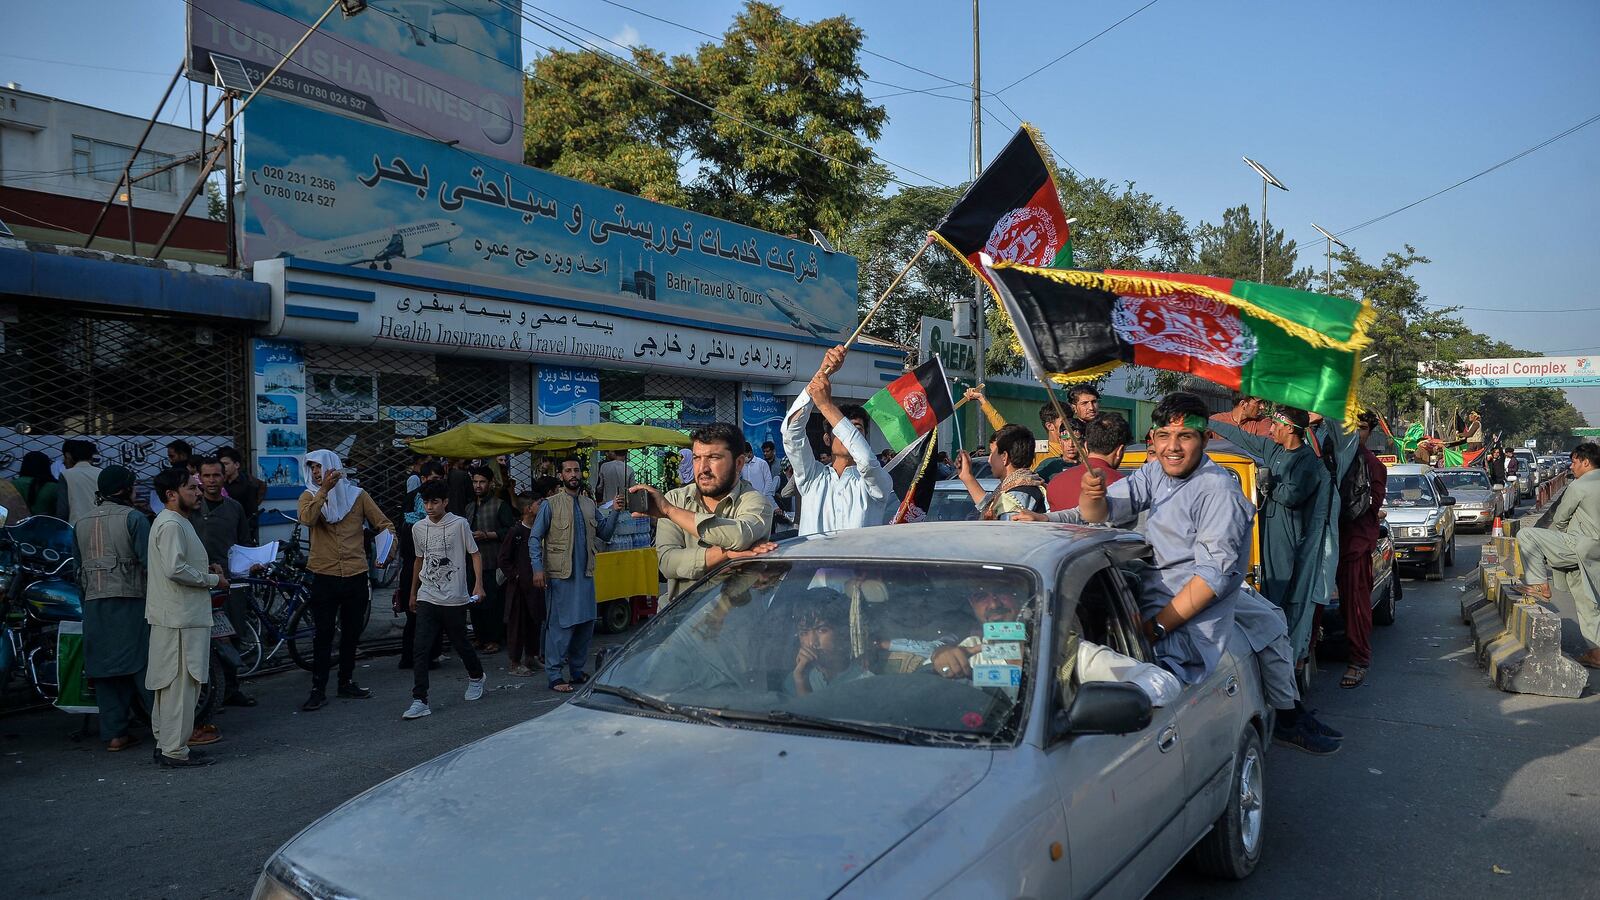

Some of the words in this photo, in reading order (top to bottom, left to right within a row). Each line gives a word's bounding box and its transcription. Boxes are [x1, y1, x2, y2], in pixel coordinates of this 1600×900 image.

[303, 83, 327, 99] 0780
[330, 91, 347, 105] 024
[350, 96, 367, 110] 527
[263, 166, 284, 180] 020
[287, 171, 306, 185] 231
[310, 176, 336, 191] 2356
[358, 154, 428, 199] بحر
[264, 184, 291, 199] 0780
[294, 190, 314, 203] 024
[317, 195, 336, 207] 527
[439, 166, 556, 223] سیاحتی
[566, 203, 582, 234] و
[590, 204, 693, 255] توریستی
[475, 238, 509, 260] عمره
[515, 247, 539, 267] حج
[699, 228, 761, 266] خدمات
[577, 254, 608, 276] اخذ
[766, 244, 818, 283] شرکت
[667, 272, 691, 292] Bahr
[694, 278, 724, 298] Travel
[727, 284, 735, 299] &
[737, 287, 763, 305] Tours
[397, 293, 454, 314] سفری
[459, 300, 511, 325] بیمه
[517, 313, 526, 325] و
[531, 312, 567, 329] صحی
[572, 315, 614, 334] بیمه
[378, 315, 432, 340] Health
[437, 323, 505, 348] Insurance
[510, 331, 522, 350] &
[527, 332, 568, 354] Travel
[571, 335, 625, 359] Insurance
[633, 332, 682, 358] خارجی
[929, 325, 975, 371] SHEFA
[687, 342, 696, 360] و
[699, 339, 735, 365] داخلی
[559, 368, 572, 381] اخذ
[574, 371, 600, 383] خدمات
[1464, 363, 1509, 376] Medical
[1513, 361, 1567, 376] Complex
[548, 383, 572, 395] عمره
[574, 384, 588, 397] حج
